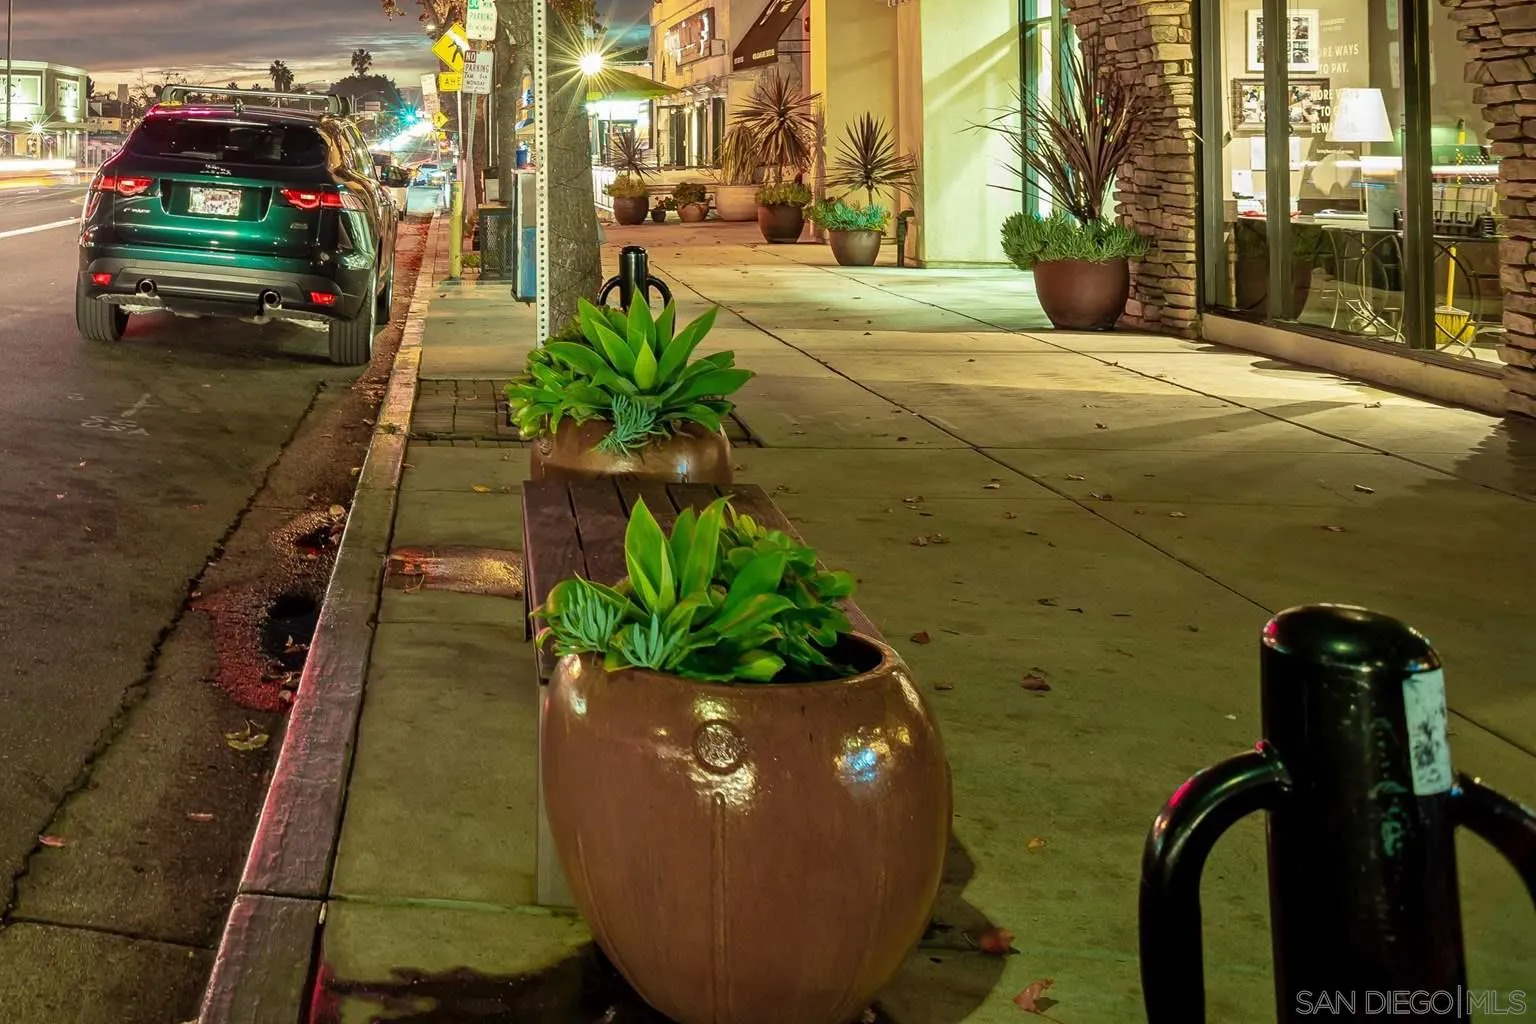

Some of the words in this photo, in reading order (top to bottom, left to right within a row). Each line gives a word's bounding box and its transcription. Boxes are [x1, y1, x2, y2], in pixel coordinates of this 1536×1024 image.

[1334, 43, 1359, 57] WAYS
[465, 51, 476, 62] NO
[465, 63, 490, 73] PARKING
[1330, 62, 1349, 74] PAY.
[1320, 106, 1331, 117] TO
